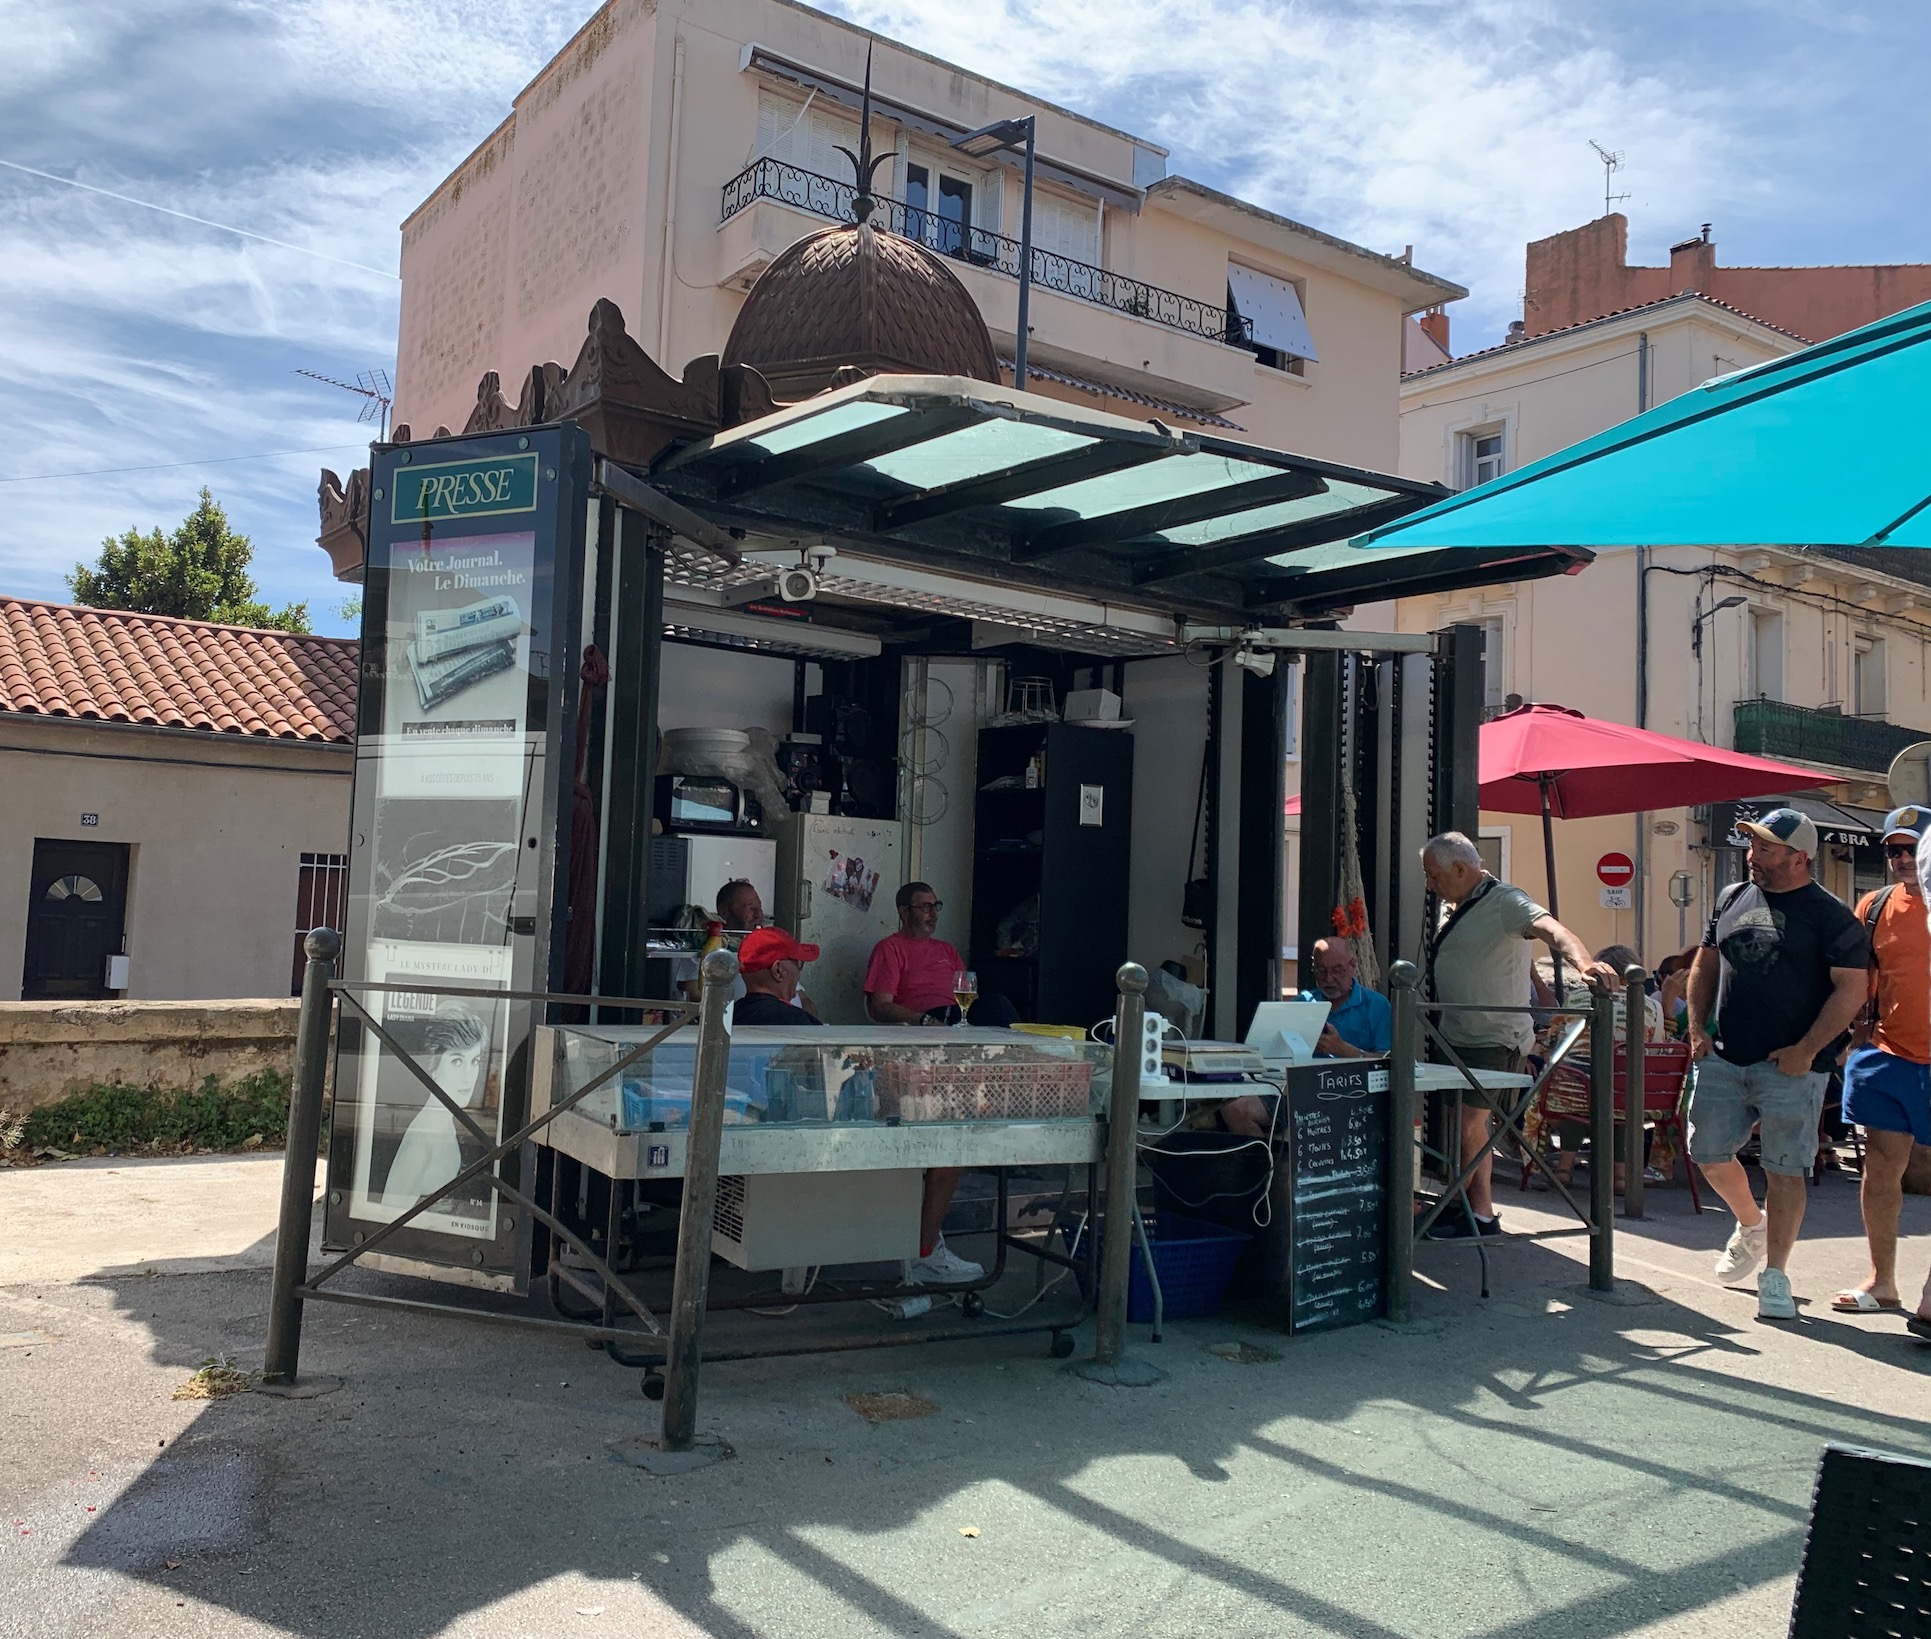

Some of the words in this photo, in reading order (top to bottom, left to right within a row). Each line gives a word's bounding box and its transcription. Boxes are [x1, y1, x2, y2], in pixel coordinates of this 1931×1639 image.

[415, 468, 514, 514] PRESSE
[408, 558, 444, 574] Votre
[446, 550, 503, 570] Journal.
[434, 575, 451, 591] Le
[454, 569, 526, 590] Dimanche.
[406, 726, 418, 736] En
[419, 727, 441, 736] vente
[441, 725, 471, 737] chaque
[471, 724, 513, 735] dimanche
[83, 815, 97, 825] 38
[400, 961, 409, 969] LE
[454, 963, 478, 973] LADY
[1297, 1128, 1303, 1140] 6
[1297, 1144, 1303, 1157] 6
[1297, 1160, 1303, 1173] 6
